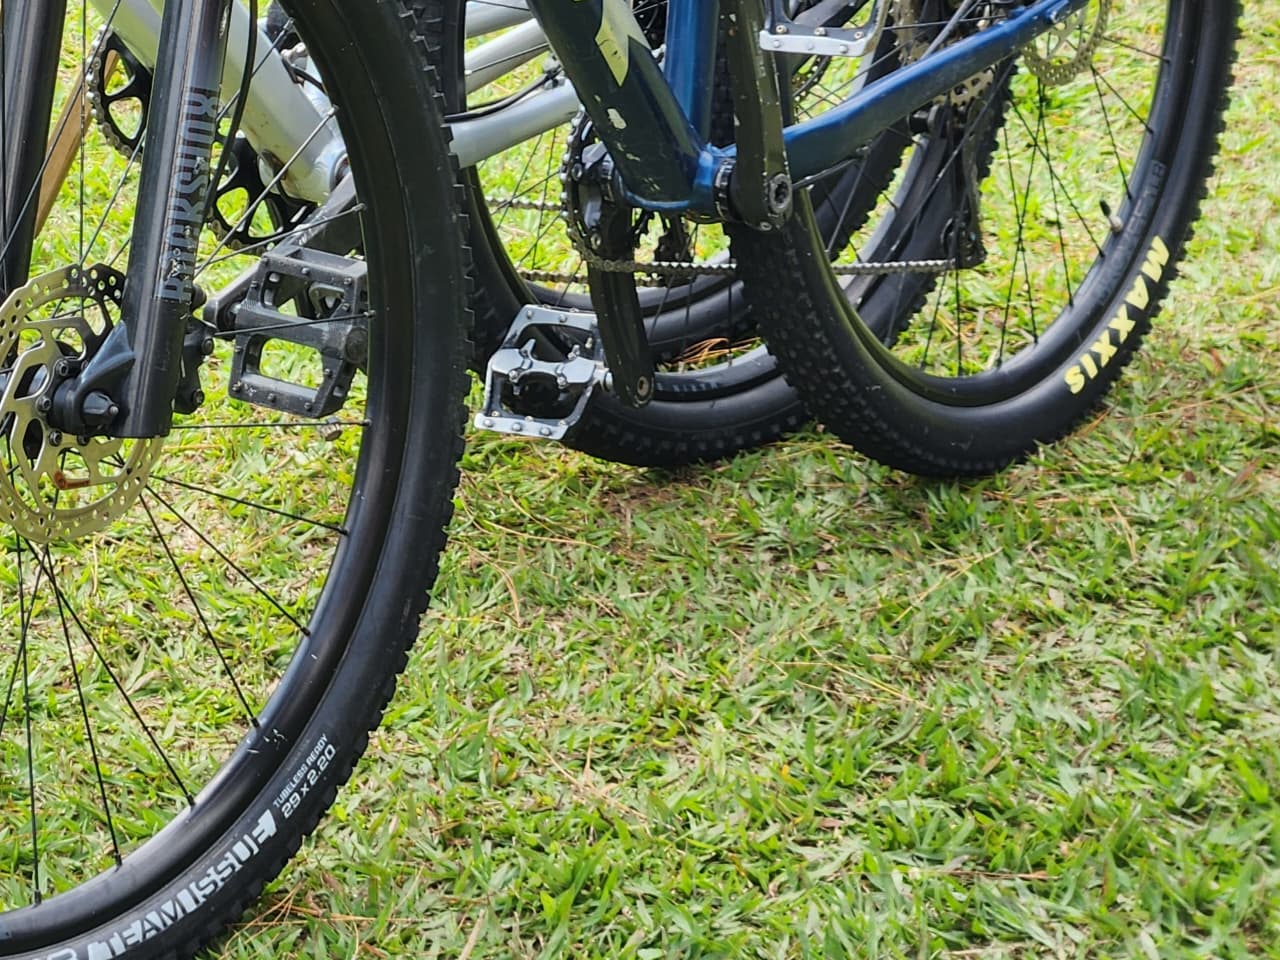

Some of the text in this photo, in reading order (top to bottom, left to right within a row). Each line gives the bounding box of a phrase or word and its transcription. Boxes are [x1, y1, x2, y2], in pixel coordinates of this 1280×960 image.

[1064, 235, 1170, 395] MAXXIS
[272, 734, 329, 809] TUBELESS READY
[280, 795, 301, 819] 29
[306, 743, 337, 785] 2.20
